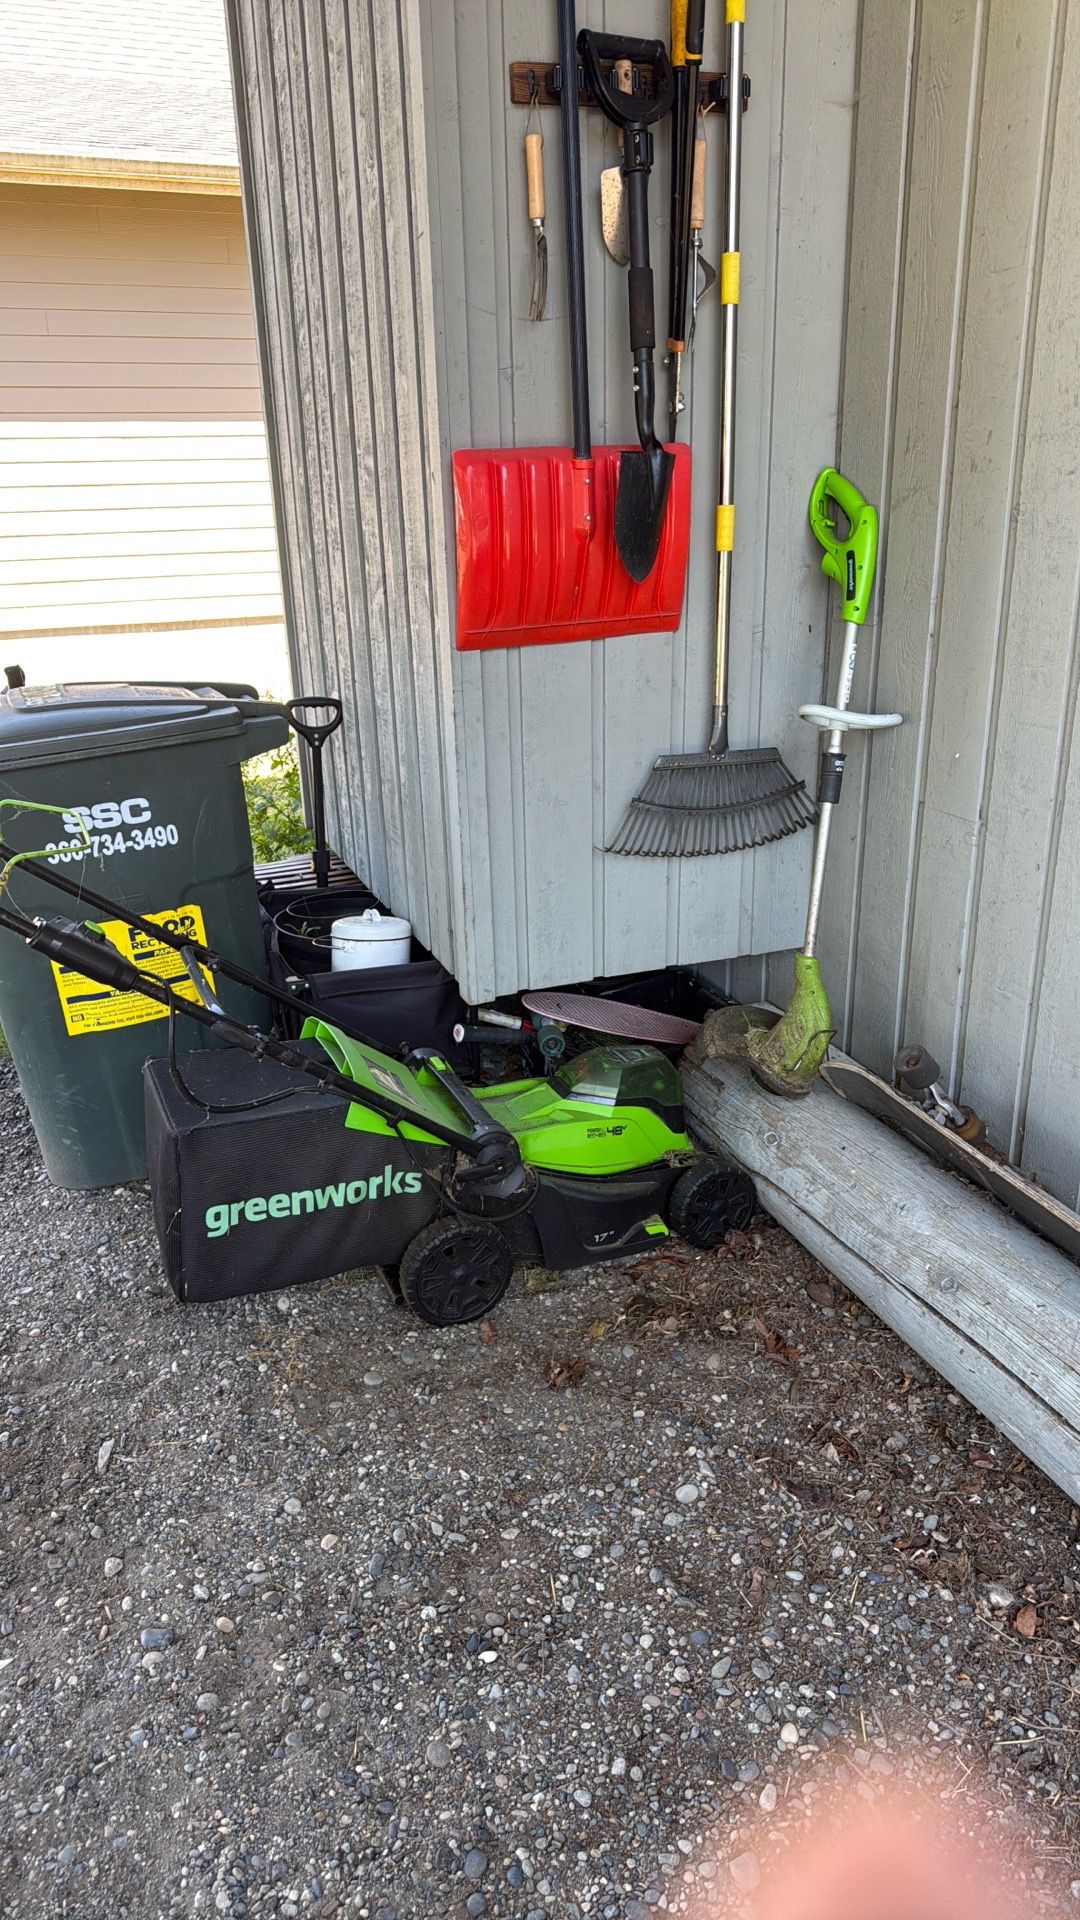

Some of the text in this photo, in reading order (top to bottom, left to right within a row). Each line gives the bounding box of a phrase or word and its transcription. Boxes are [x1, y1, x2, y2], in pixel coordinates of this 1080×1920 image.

[62, 798, 152, 833] SSC
[45, 824, 179, 865] 360-734-3490
[205, 1164, 422, 1238] greenworks
